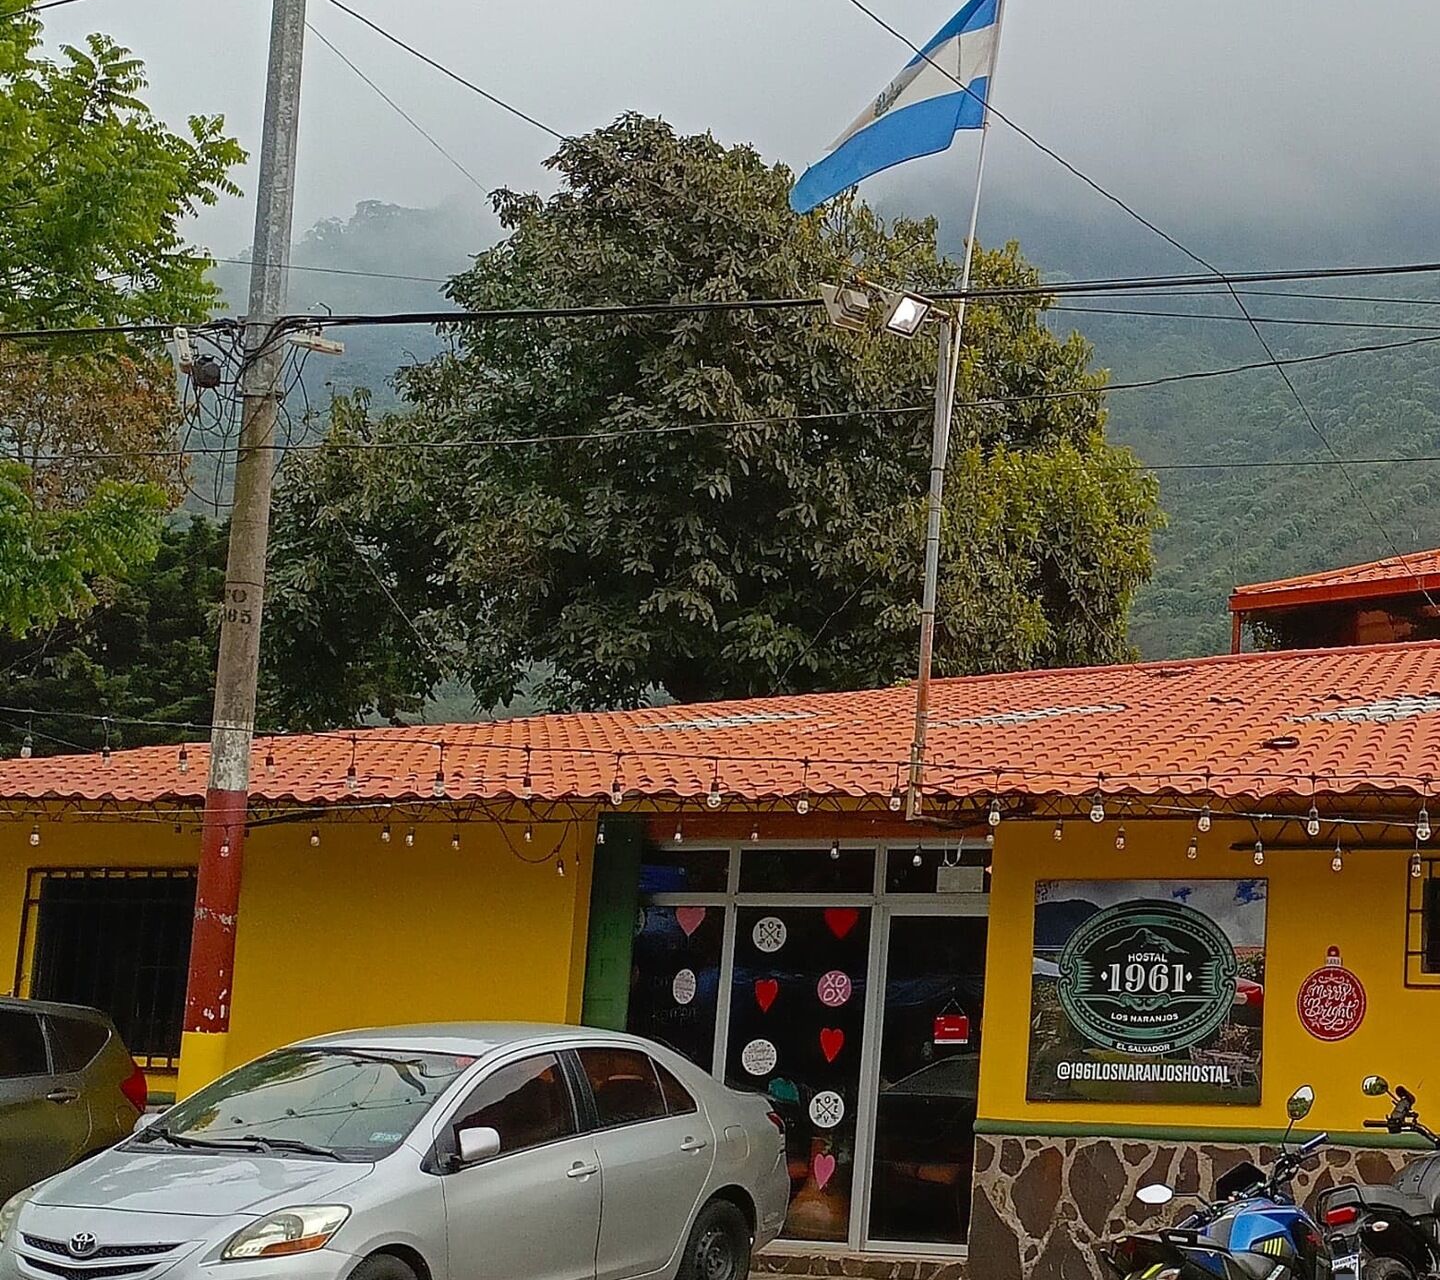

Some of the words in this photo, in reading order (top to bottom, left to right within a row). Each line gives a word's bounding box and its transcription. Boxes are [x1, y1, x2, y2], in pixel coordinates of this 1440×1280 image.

[1128, 952, 1168, 963] HOSTAL
[823, 974, 847, 989] XO
[1107, 963, 1186, 993] 1961
[823, 988, 846, 1003] OX
[1110, 1012, 1128, 1022] LOS
[1130, 1012, 1179, 1023] NARANJOS
[1304, 997, 1359, 1028] Bright
[1116, 1042, 1127, 1051] EL
[1127, 1043, 1170, 1053] SALVADOR
[1057, 1062, 1231, 1083] @1961LOSNARANJOSHOSTAL
